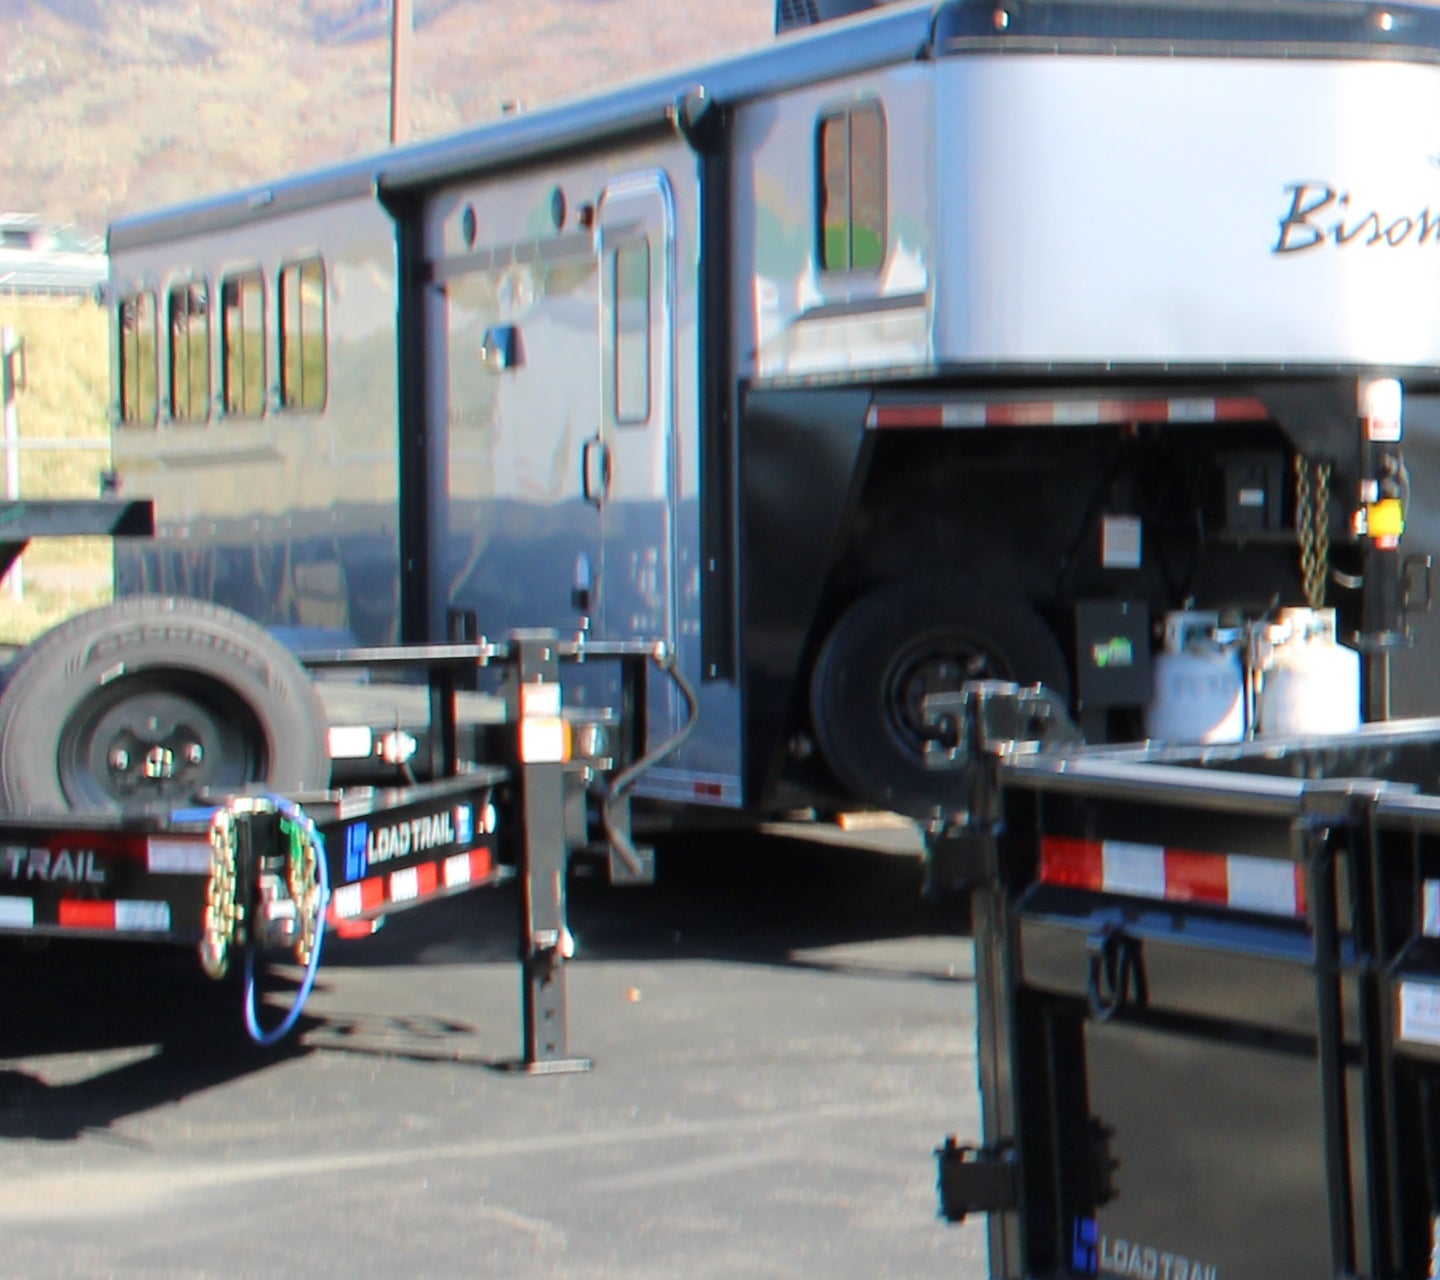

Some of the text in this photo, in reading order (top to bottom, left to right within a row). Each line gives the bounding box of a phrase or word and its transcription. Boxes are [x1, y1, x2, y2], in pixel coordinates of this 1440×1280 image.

[367, 821, 411, 865] LOAD
[411, 811, 454, 853] TRAIL
[5, 845, 107, 884] TRAIL
